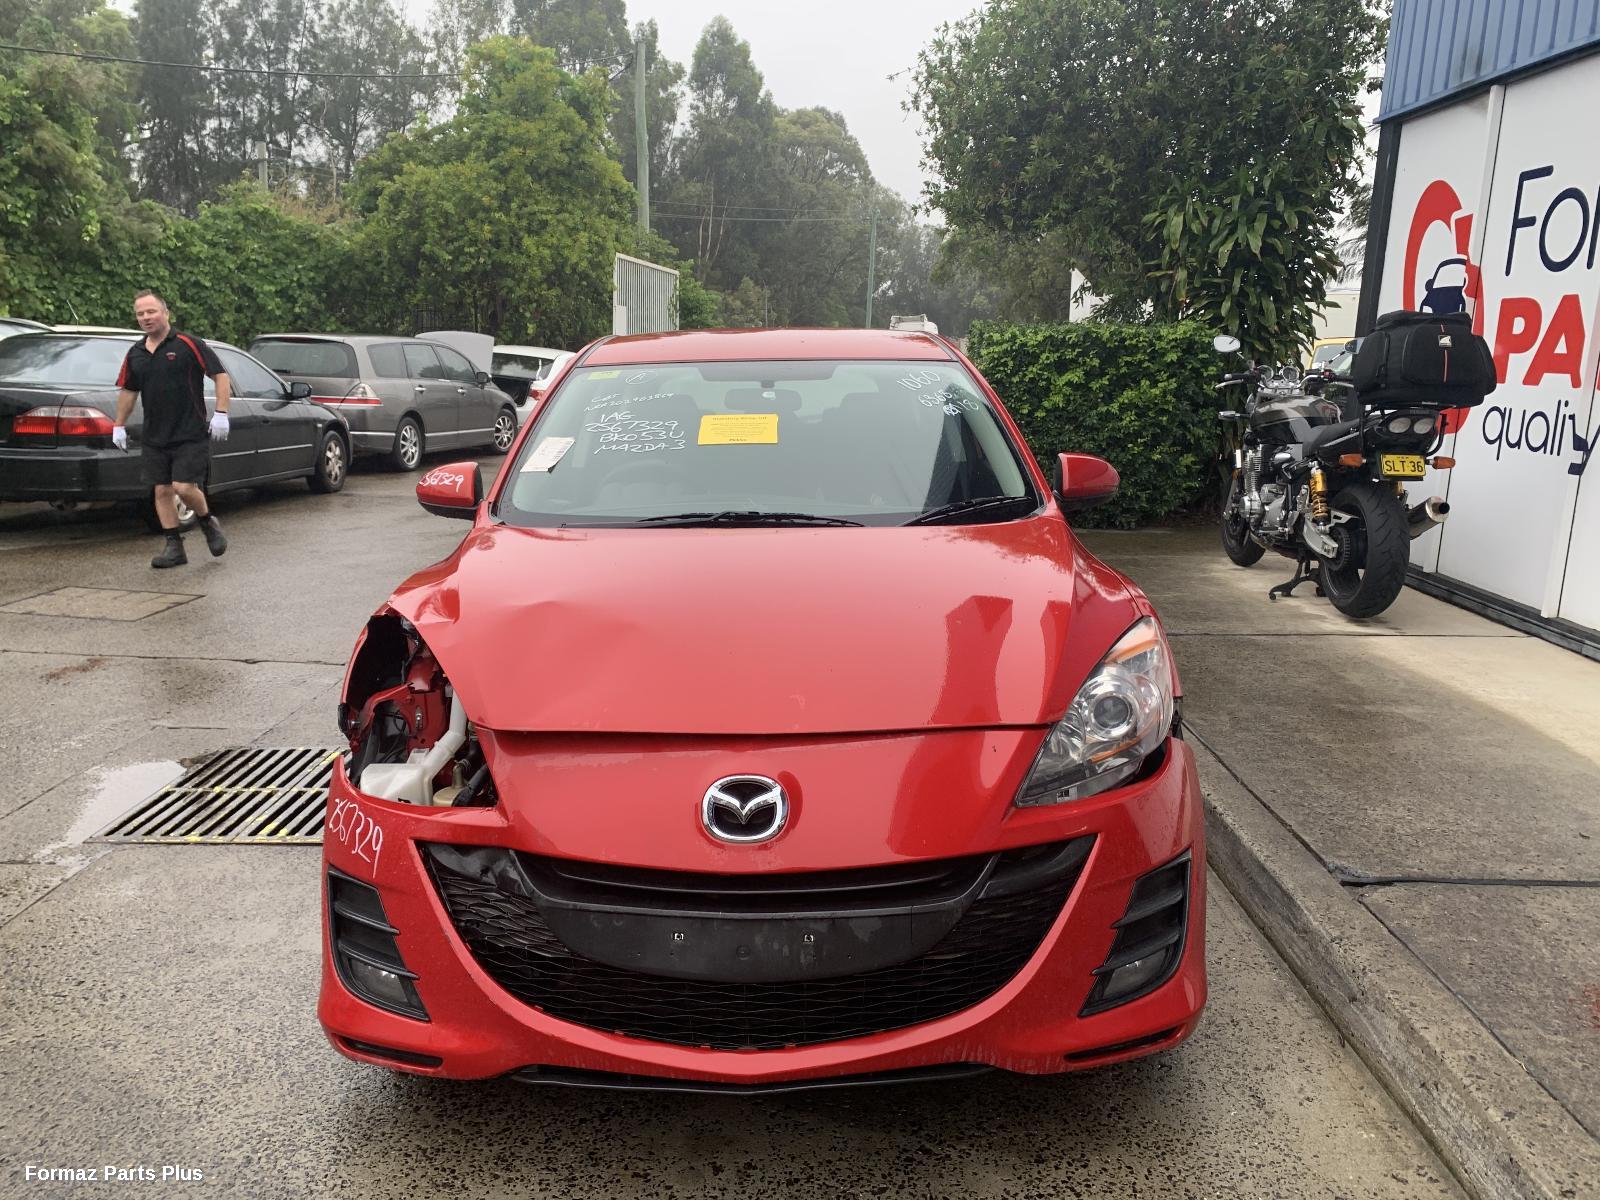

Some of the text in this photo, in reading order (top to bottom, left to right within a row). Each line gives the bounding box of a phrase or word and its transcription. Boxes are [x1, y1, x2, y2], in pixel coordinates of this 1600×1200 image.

[1492, 293, 1600, 390] PA
[593, 439, 686, 455] MAZDA 3
[1384, 460, 1424, 472] SLT 36
